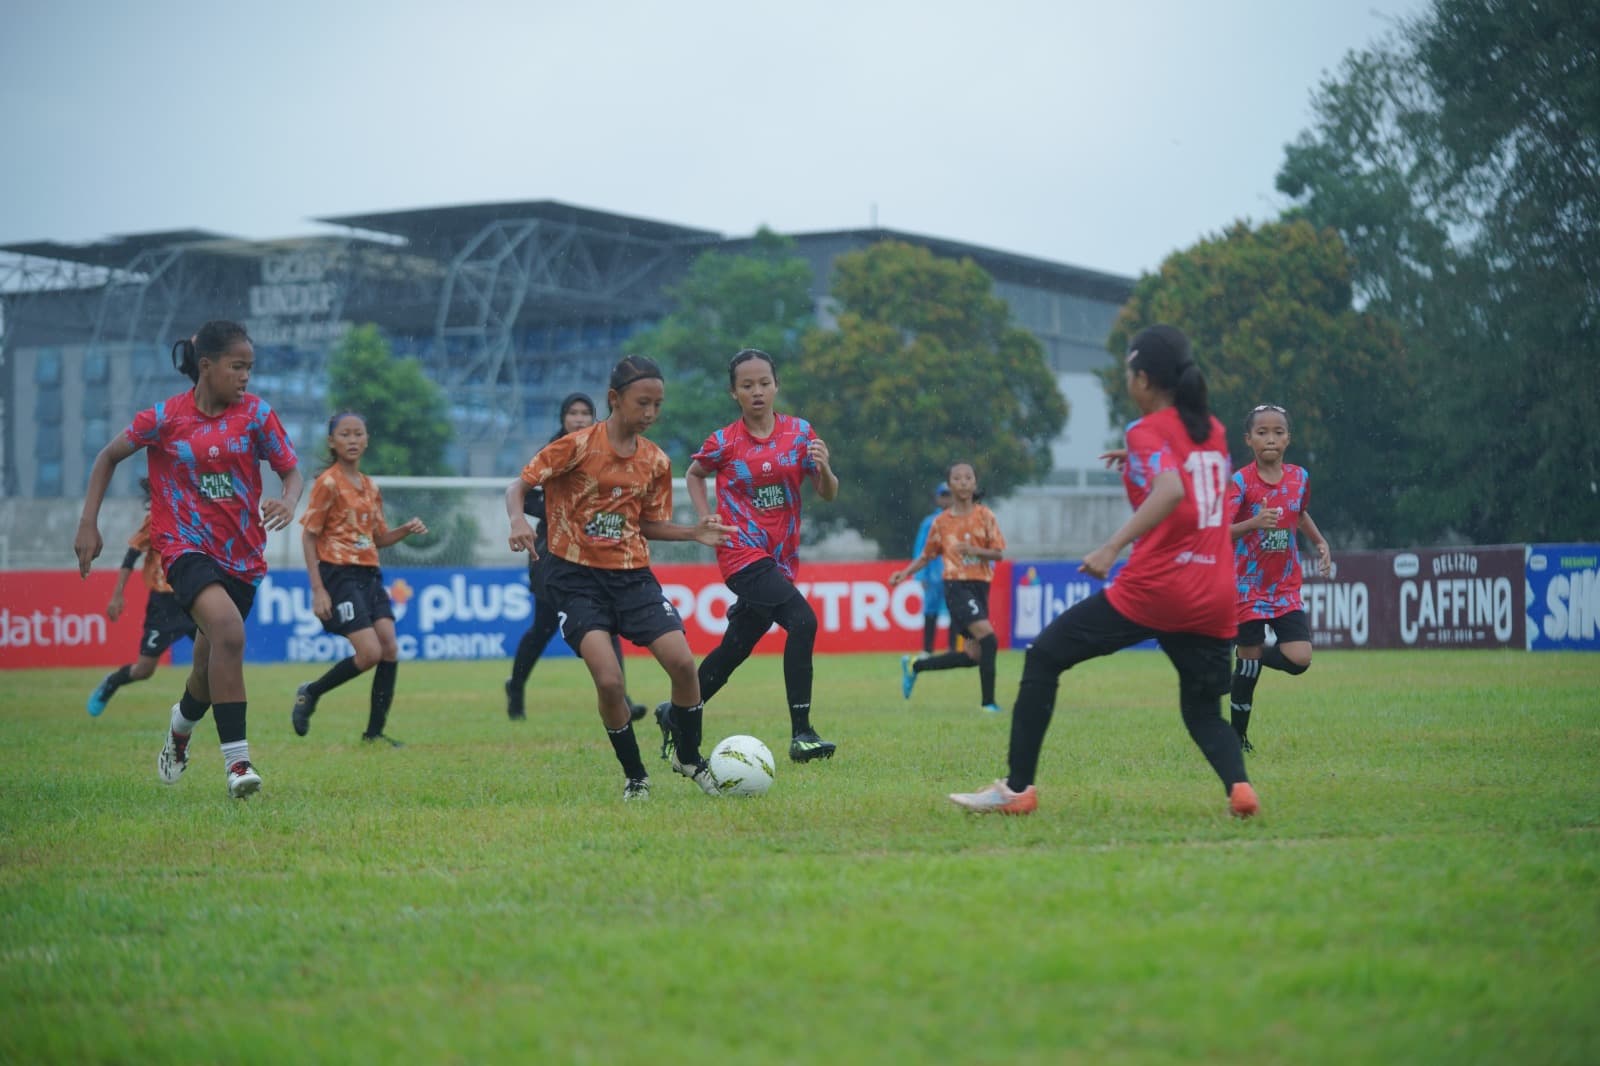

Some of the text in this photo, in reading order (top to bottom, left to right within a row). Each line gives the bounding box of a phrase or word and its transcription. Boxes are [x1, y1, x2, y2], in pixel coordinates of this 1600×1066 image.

[758, 485, 783, 498] Milk
[764, 496, 784, 508] Life
[1183, 451, 1227, 529] 10
[596, 513, 623, 526] Milk
[1432, 552, 1478, 577] DELIZIO
[336, 601, 355, 624] 10
[418, 573, 532, 633] plus
[967, 598, 979, 616] 5
[1400, 577, 1512, 644] CAFFINO
[147, 620, 160, 648] 2
[557, 610, 568, 639] 7
[424, 632, 506, 660] DRINK
